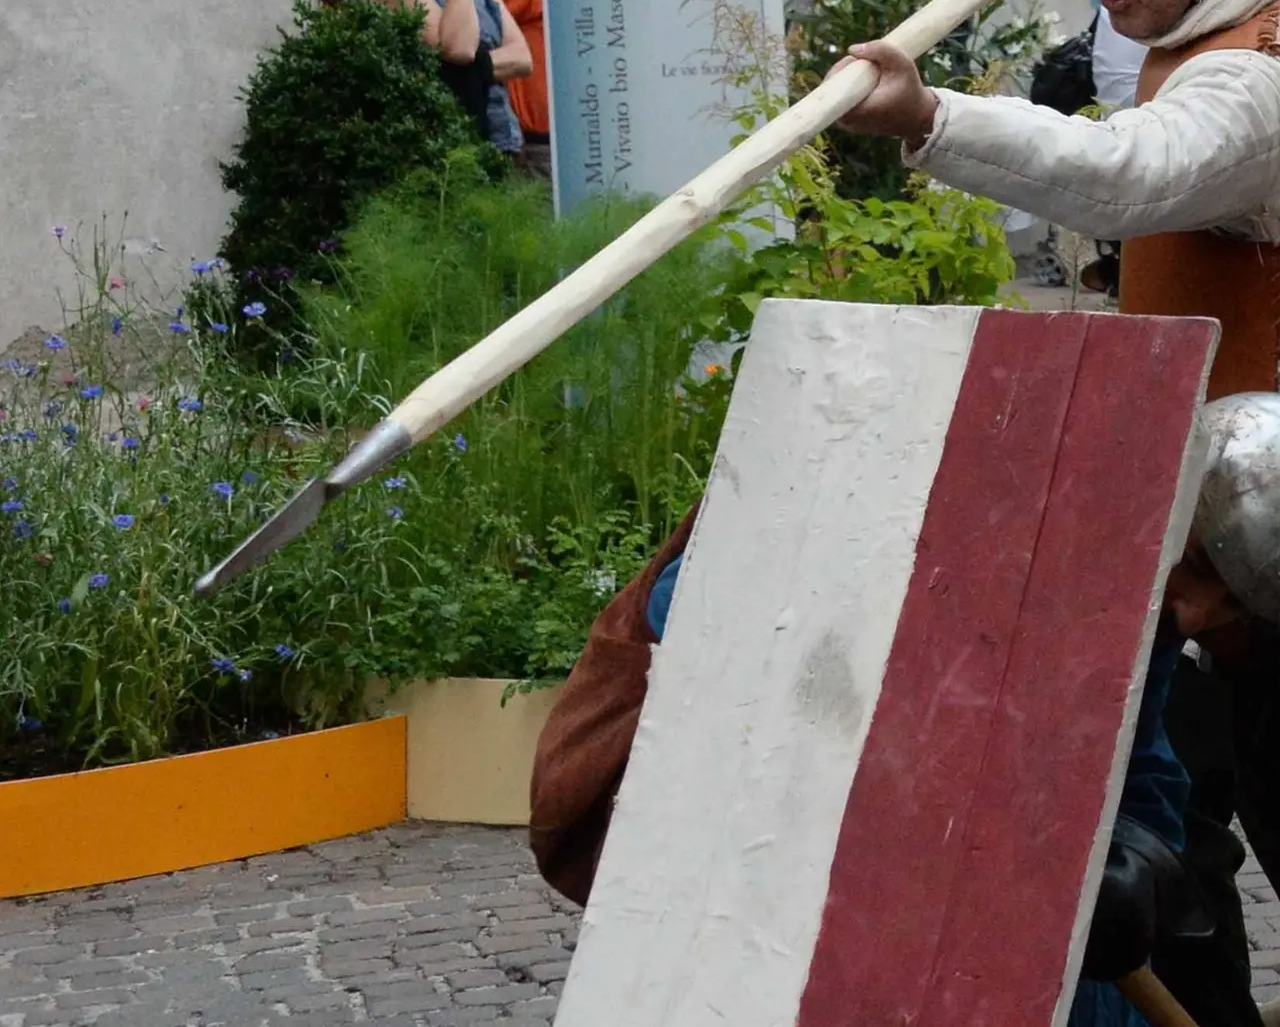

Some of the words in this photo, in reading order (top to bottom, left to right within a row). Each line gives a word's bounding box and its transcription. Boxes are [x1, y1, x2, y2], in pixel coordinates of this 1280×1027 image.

[574, 7, 595, 56] Villa
[608, 58, 628, 92] bio
[580, 83, 603, 186] Murialdo
[611, 102, 632, 173] Vivaio
